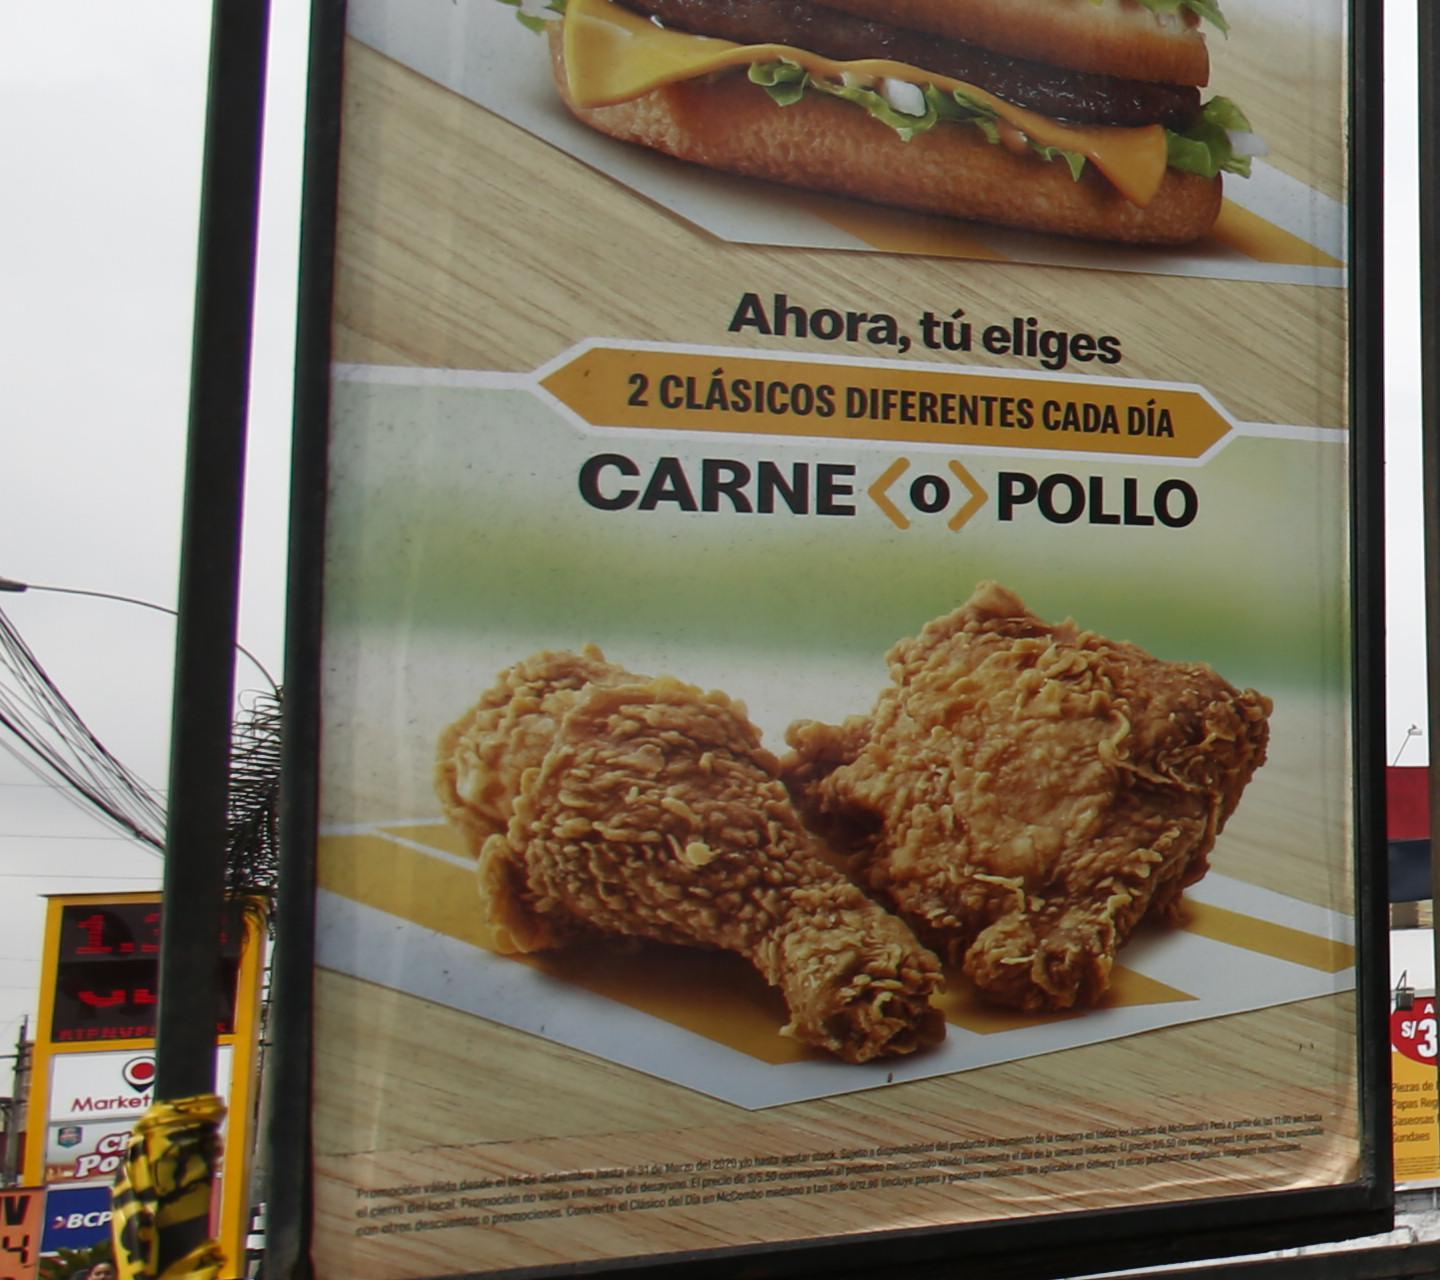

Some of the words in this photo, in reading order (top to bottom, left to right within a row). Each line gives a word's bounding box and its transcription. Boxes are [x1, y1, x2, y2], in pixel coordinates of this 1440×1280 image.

[728, 293, 911, 355] Ahora,
[919, 308, 973, 353] tú
[981, 317, 1122, 372] eliges
[627, 372, 649, 408] 2
[660, 368, 836, 419] CLÁSICOS
[845, 386, 1035, 432] DIFERENTES
[1041, 400, 1120, 436] CADA
[1127, 399, 1176, 440] DÍA
[577, 453, 857, 517] CARNE
[908, 473, 951, 514] o
[997, 470, 1199, 529] POLLO
[66, 1211, 112, 1229] BCP
